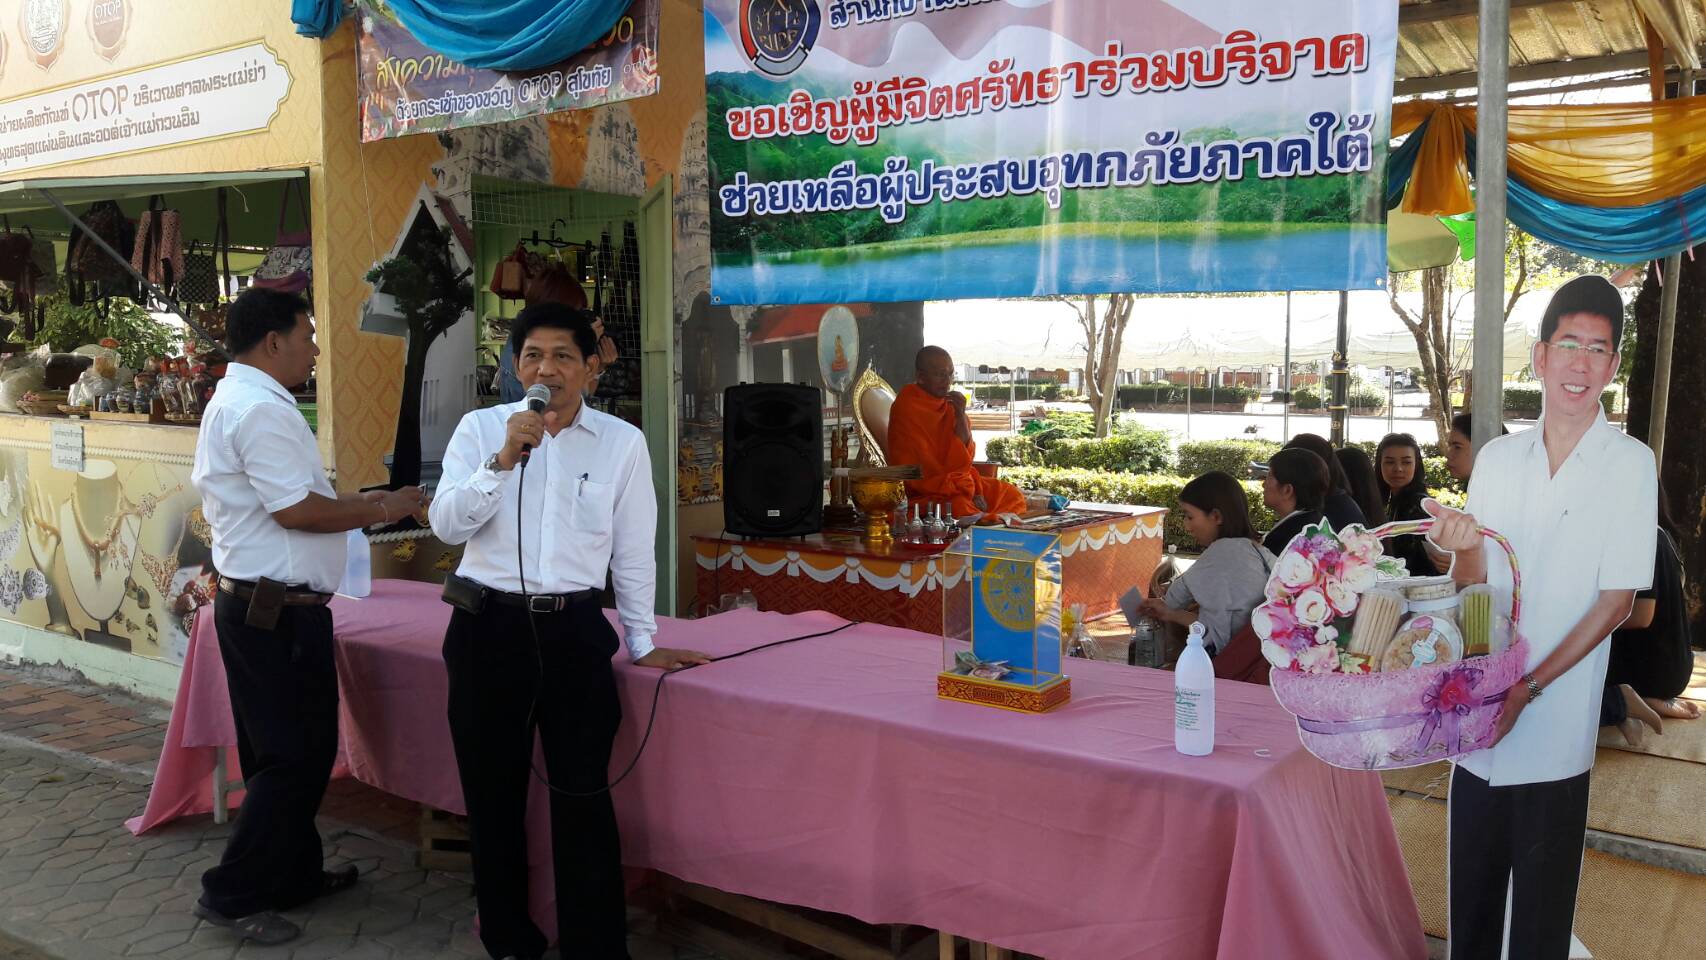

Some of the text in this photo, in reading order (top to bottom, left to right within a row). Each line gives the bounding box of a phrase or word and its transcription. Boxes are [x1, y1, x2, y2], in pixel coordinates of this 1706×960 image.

[94, 2, 121, 18] OTOP
[72, 85, 129, 122] OTOP
[132, 59, 267, 107] บริเวณศาลพระแม่ย่า
[395, 64, 611, 120] ด้วยกระเช้าของขวัญ OTOP สุโขทัย
[727, 29, 1367, 141] ขอเชิญผู้มีจิตศรัทธาร่วมบริจาค
[722, 110, 1375, 221] ช่วยเหลือผู้ประสบอุทกภัยภาคใต้
